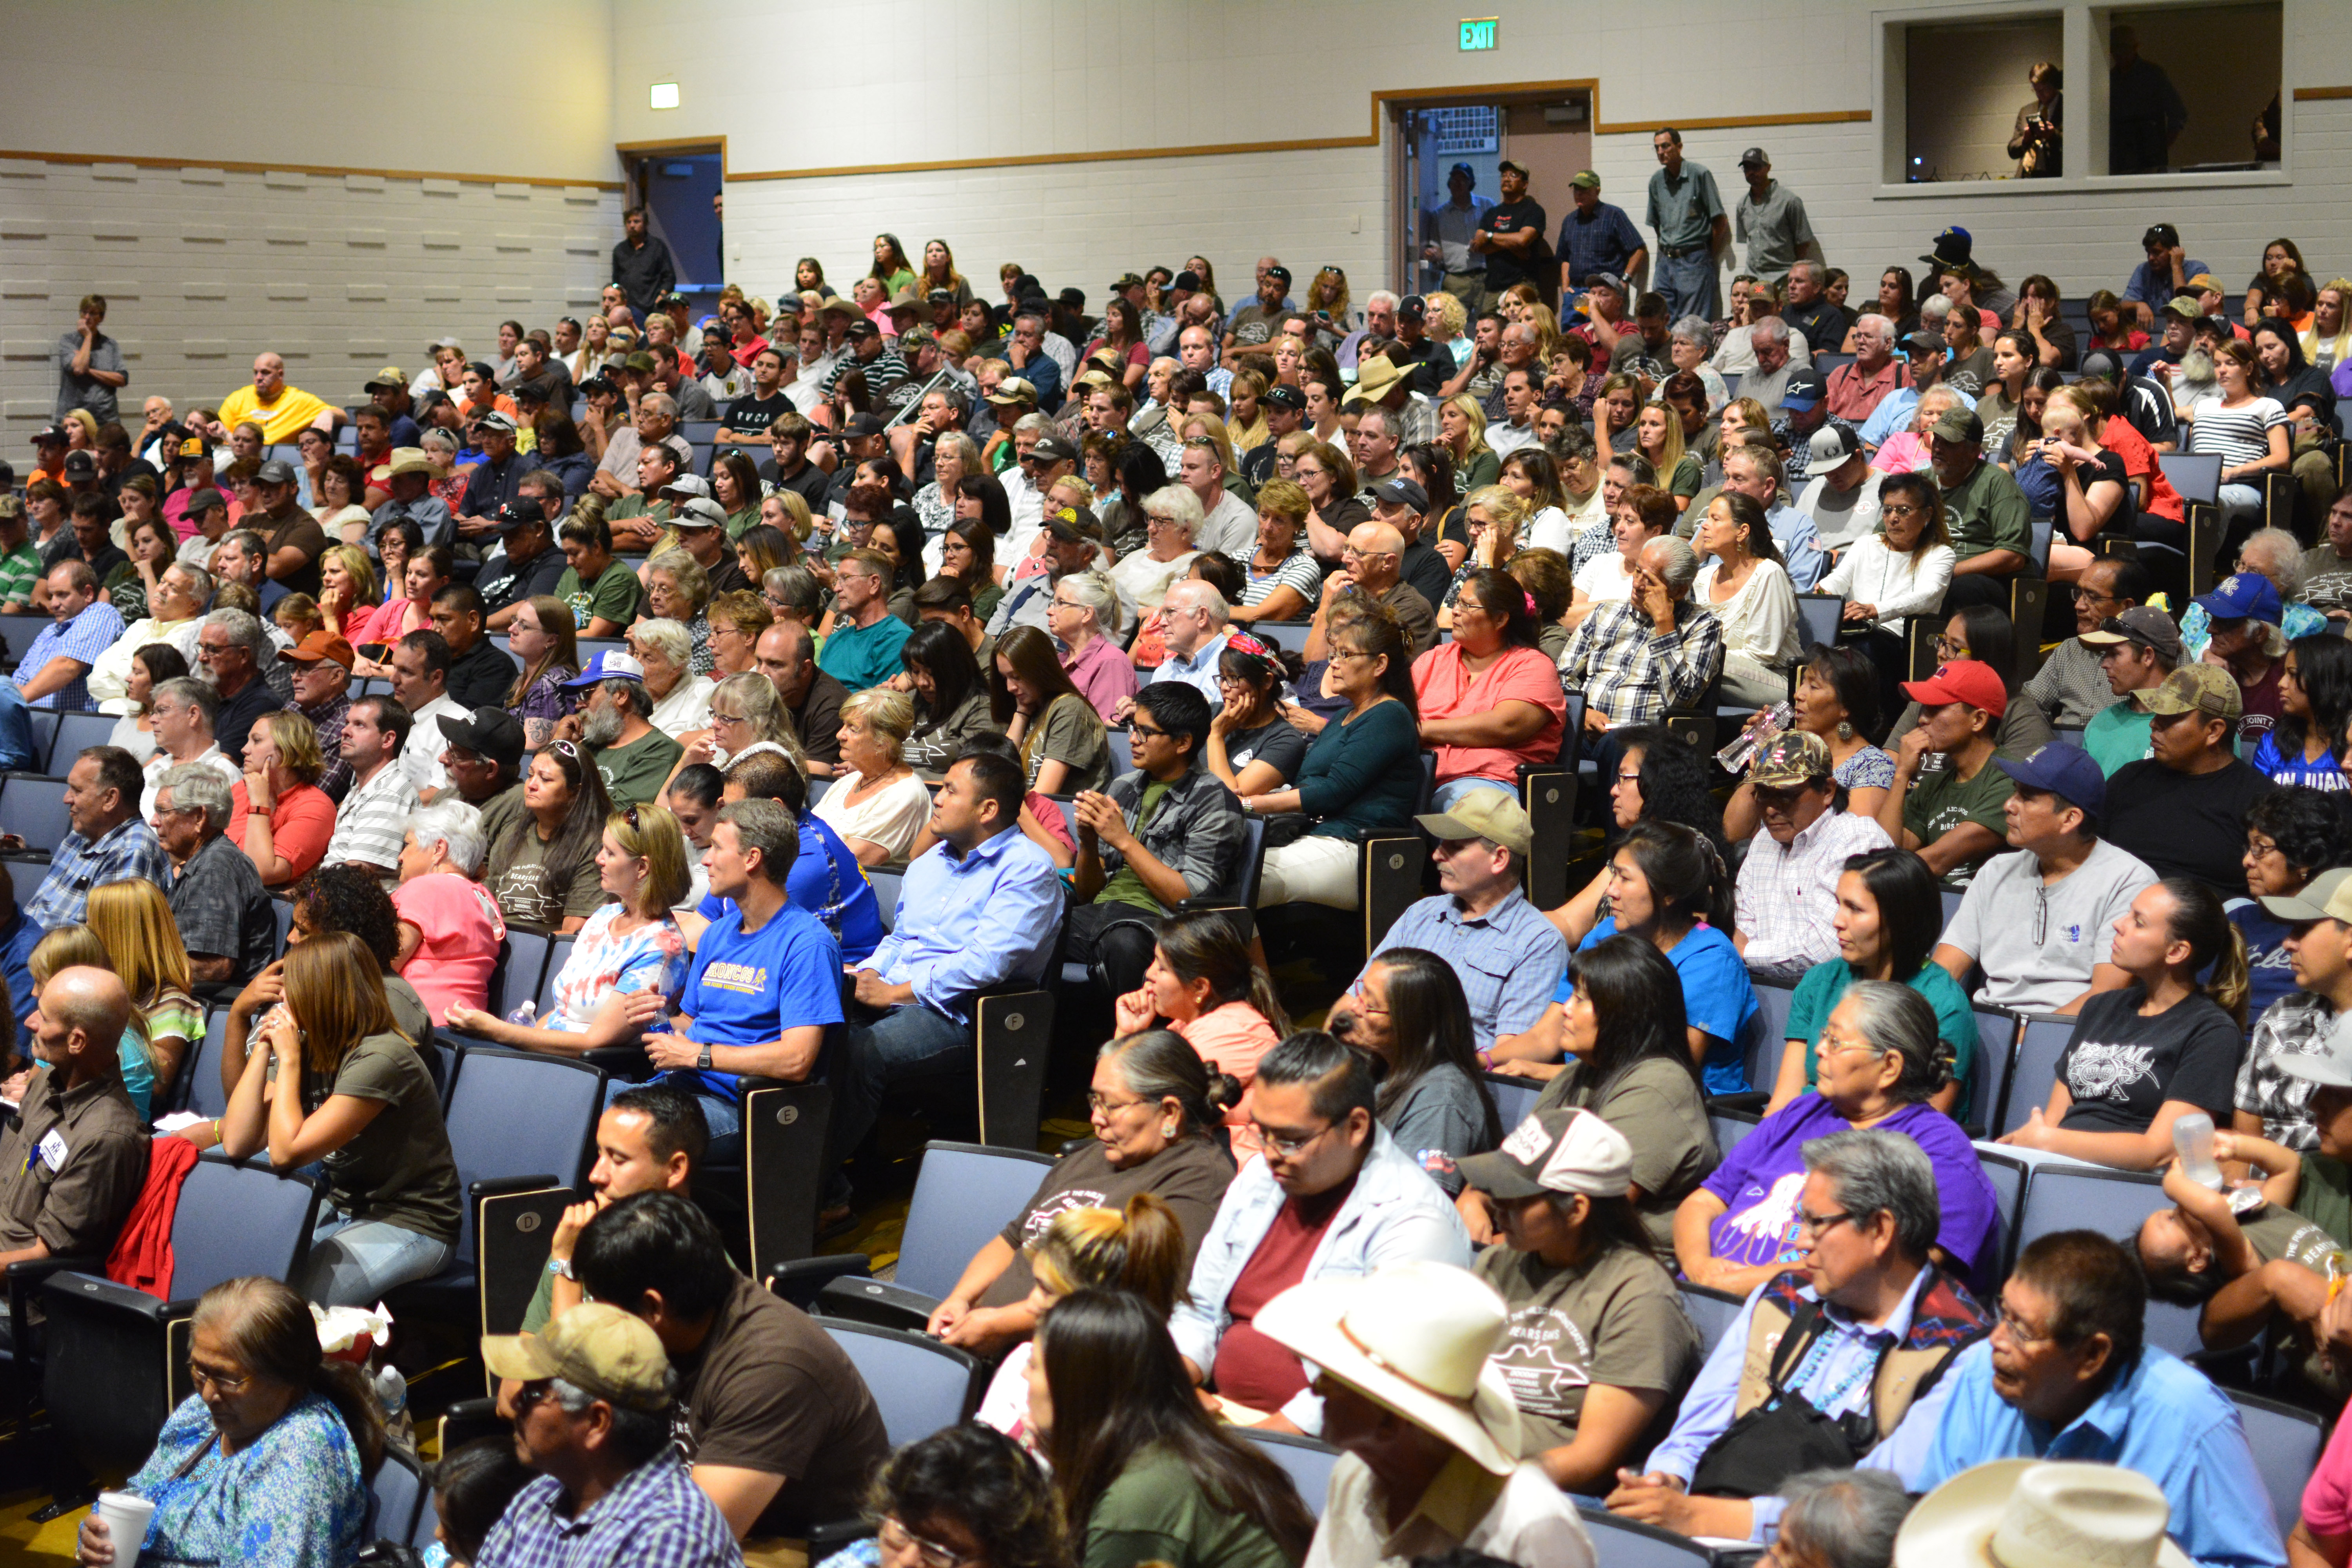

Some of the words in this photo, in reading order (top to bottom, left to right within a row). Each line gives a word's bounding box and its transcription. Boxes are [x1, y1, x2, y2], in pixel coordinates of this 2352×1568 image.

[1461, 21, 1496, 49] EXIT
[2247, 717, 2268, 725] JOINT
[2273, 773, 2296, 786] AN
[1936, 812, 1946, 820] THE
[510, 872, 528, 882] BEARS
[736, 985, 755, 995] SCHOOL
[1012, 1016, 1018, 1027] F
[784, 1109, 791, 1122] E
[524, 1216, 533, 1229] D
[2286, 1243, 2299, 1258] THE
[359, 1548, 376, 1557] Canon
